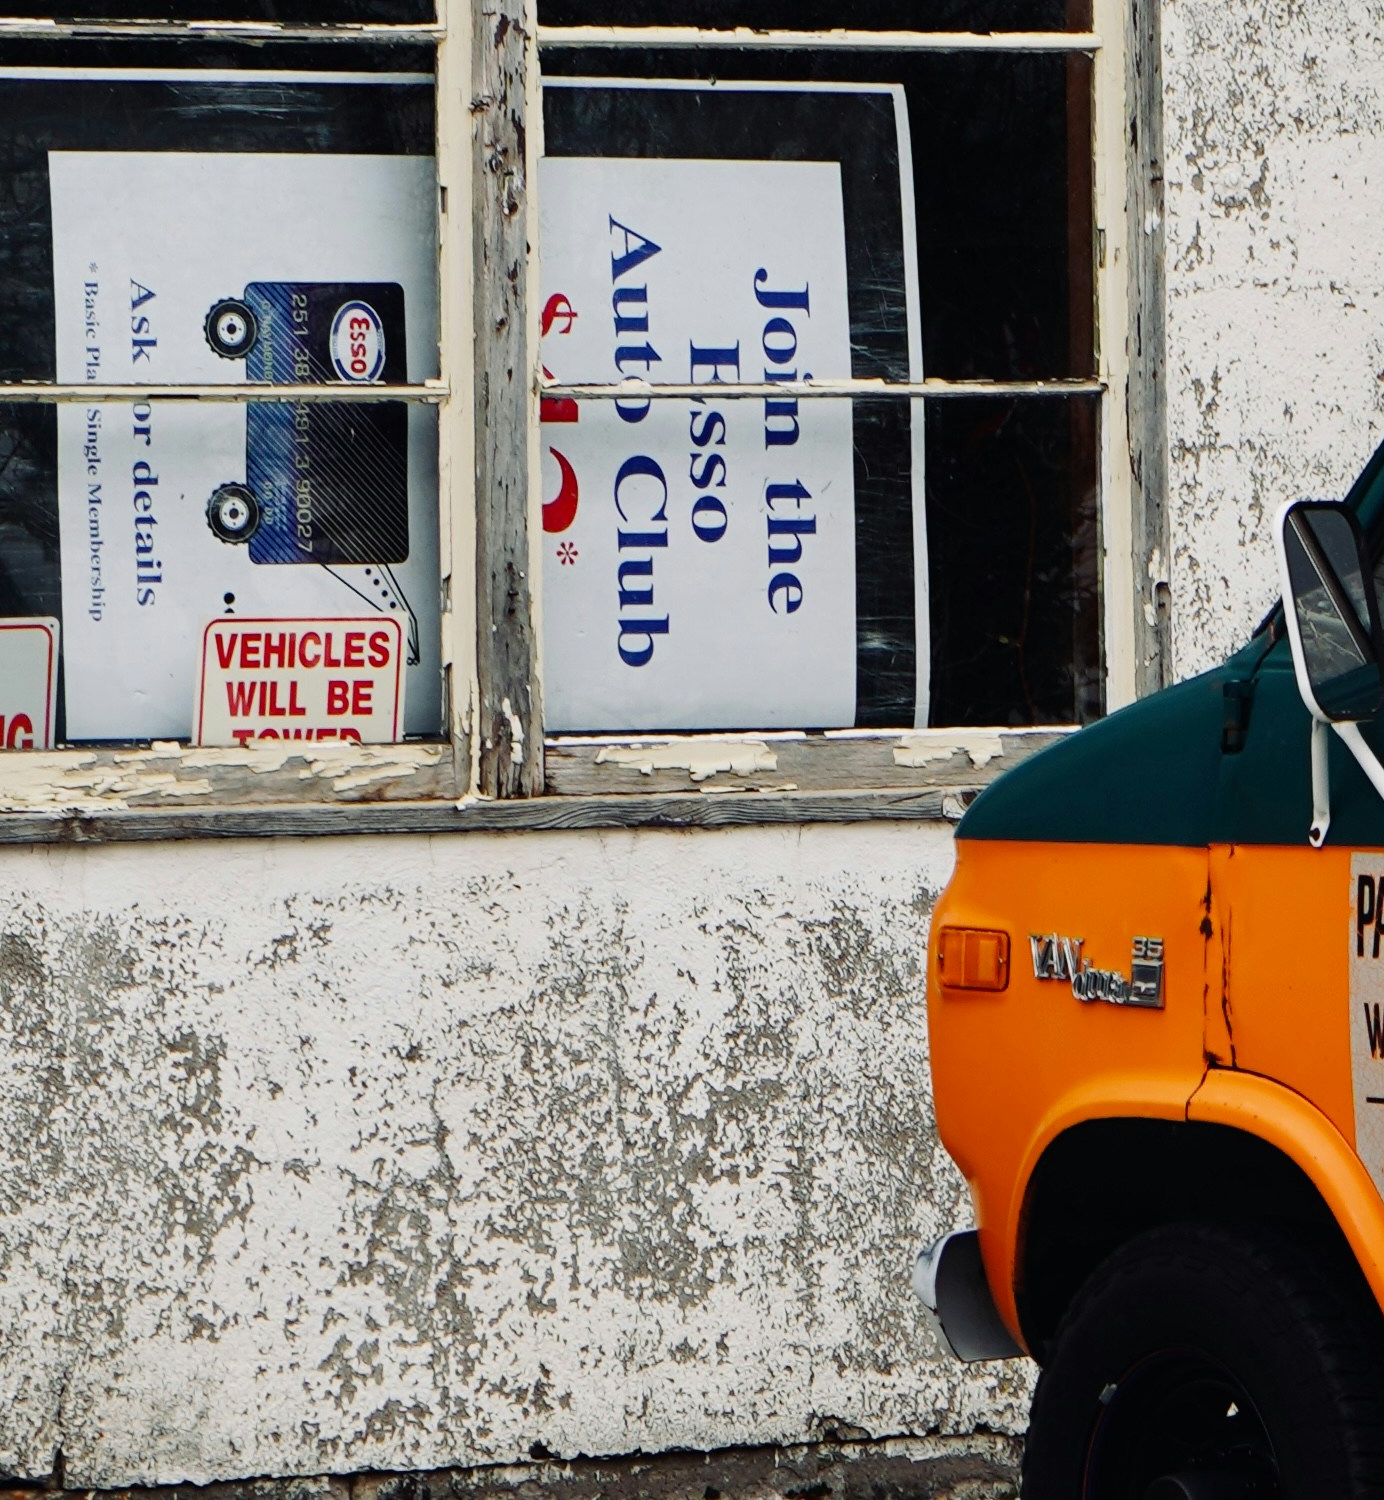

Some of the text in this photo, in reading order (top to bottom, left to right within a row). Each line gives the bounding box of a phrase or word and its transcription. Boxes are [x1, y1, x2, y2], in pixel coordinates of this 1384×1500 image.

[291, 294, 309, 337] 251
[294, 348, 310, 378] 38
[83, 281, 106, 622] Basic Pla Single Membership
[130, 278, 163, 607] Ask or details
[608, 213, 670, 668] Auto Club
[689, 338, 741, 544] Esso
[753, 266, 817, 615] Join the
[295, 479, 313, 554] 90027
[215, 631, 391, 670] VEHICLES
[226, 680, 375, 717] WILL BE
[1131, 935, 1164, 959] 35
